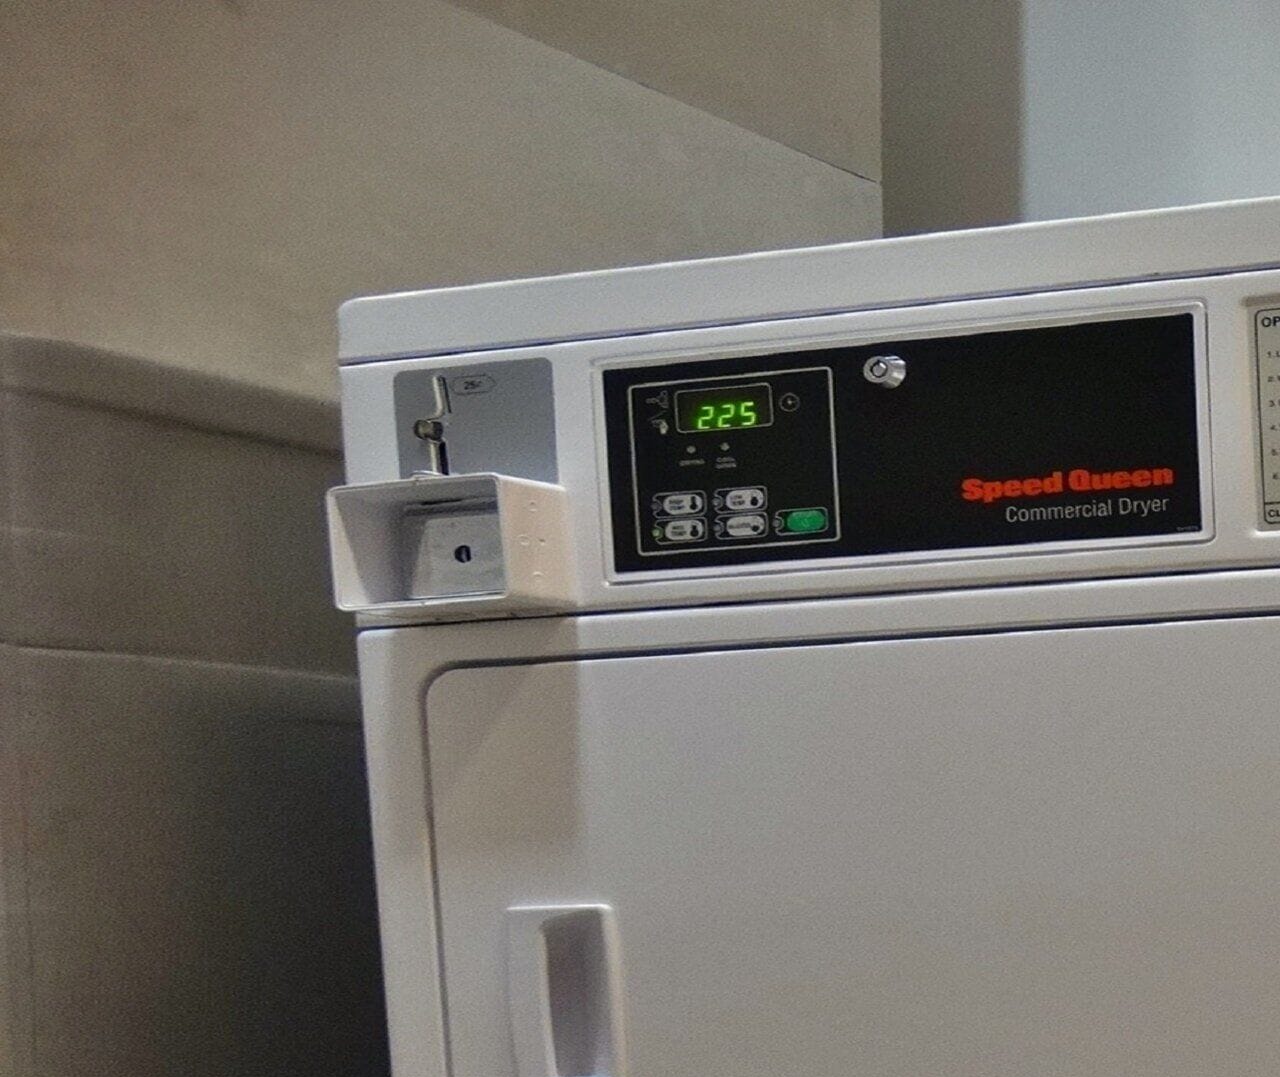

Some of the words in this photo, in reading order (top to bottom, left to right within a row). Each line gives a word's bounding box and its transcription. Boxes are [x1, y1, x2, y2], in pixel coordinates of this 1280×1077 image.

[698, 401, 757, 429] 225
[962, 472, 1063, 502] Speed
[1068, 468, 1174, 491] Queen
[1006, 499, 1112, 523] Commercial
[1119, 497, 1169, 517] Dryer
